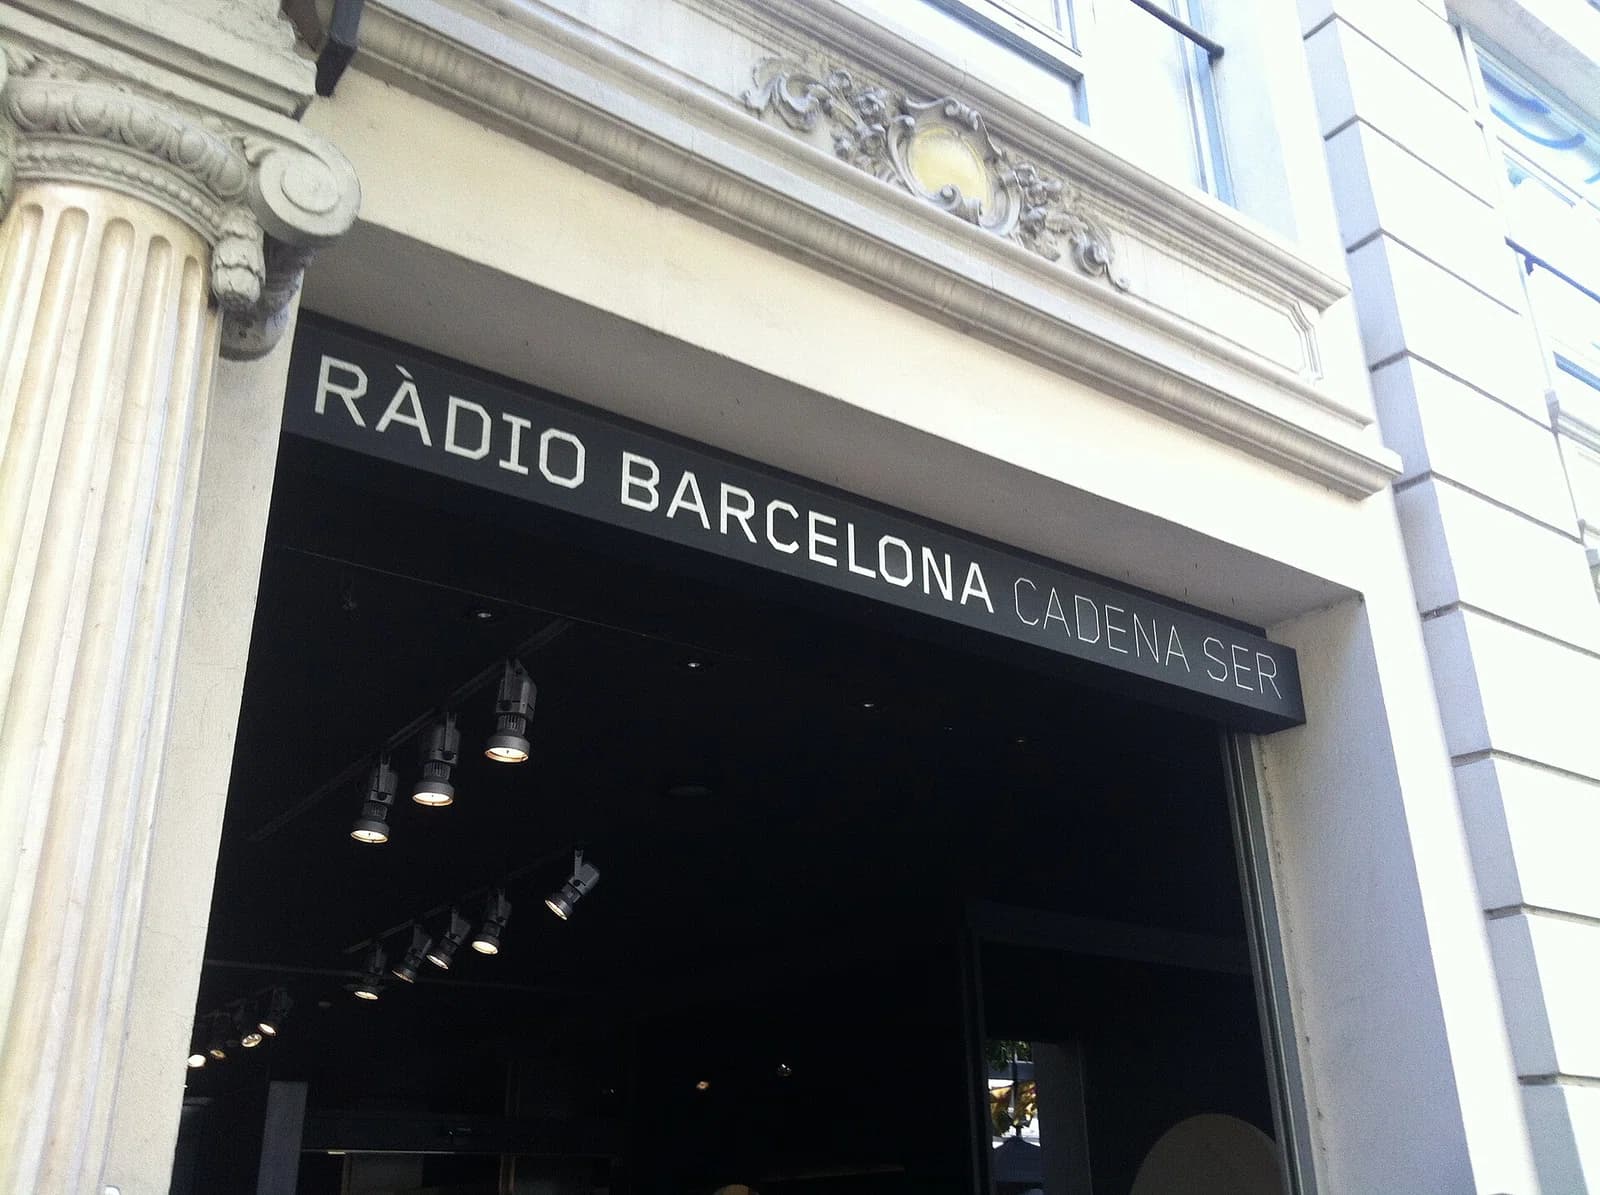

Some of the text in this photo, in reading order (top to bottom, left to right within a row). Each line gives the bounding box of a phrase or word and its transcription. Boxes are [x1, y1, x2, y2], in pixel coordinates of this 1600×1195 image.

[314, 355, 1283, 700] RÀDIO BARCELONA CADENA SER
